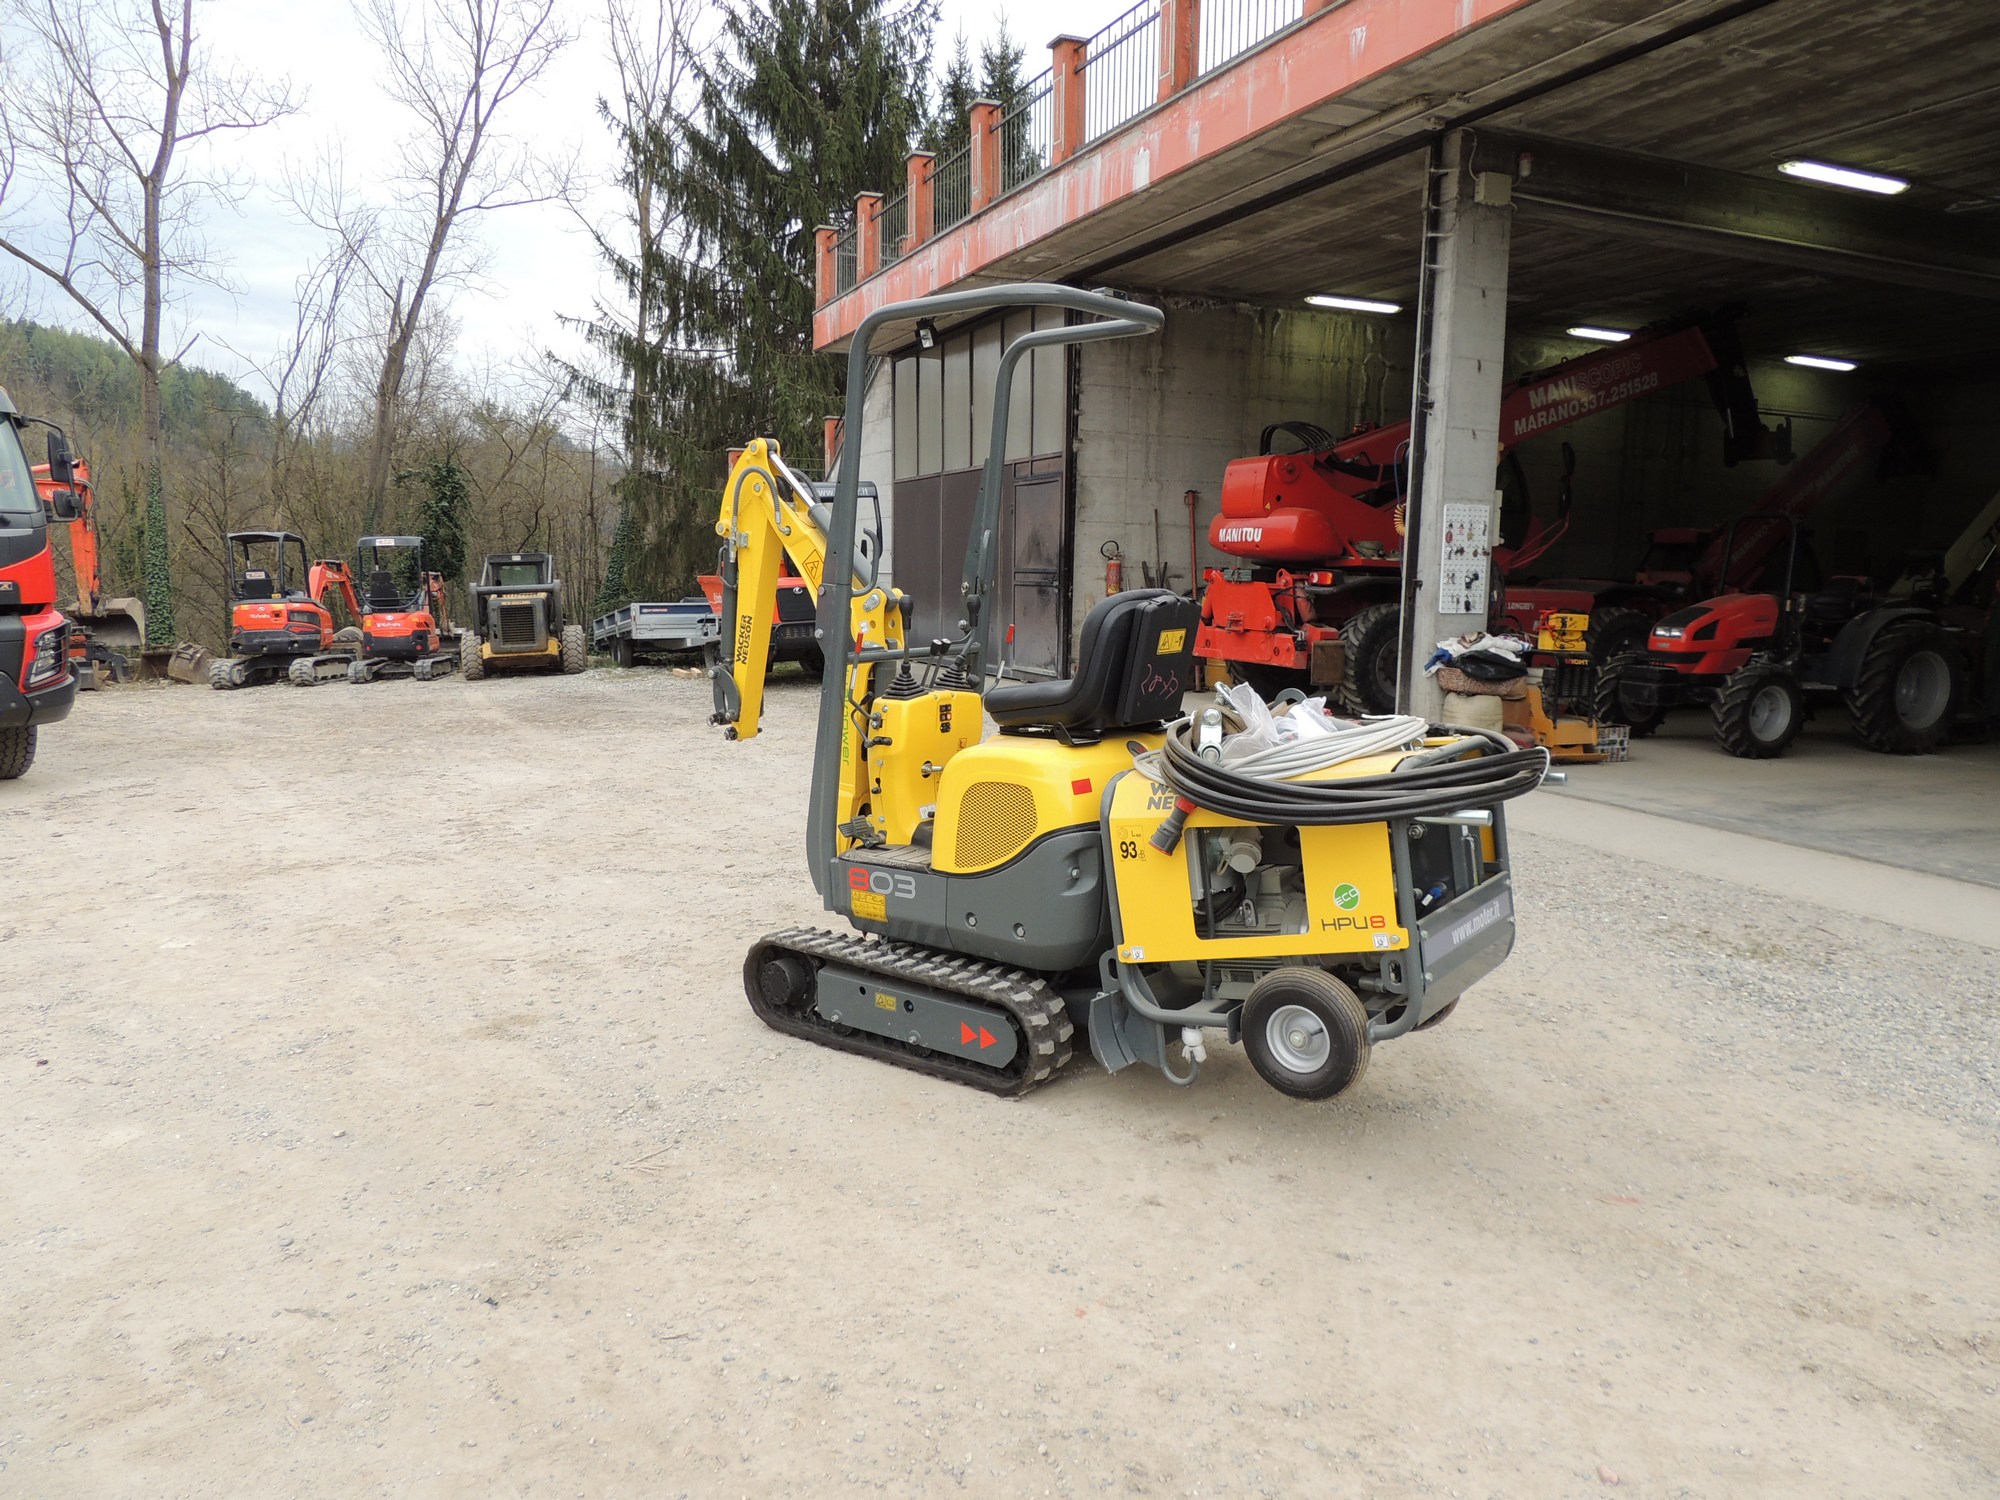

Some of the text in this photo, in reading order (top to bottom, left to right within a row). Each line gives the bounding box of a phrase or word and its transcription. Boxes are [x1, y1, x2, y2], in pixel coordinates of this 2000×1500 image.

[1514, 400, 1580, 435] MARANO
[1218, 527, 1262, 542] MANITOU
[736, 614, 748, 662] WACKER
[741, 614, 753, 665] NEUSON
[1120, 841, 1138, 859] 93
[848, 867, 916, 899] 803
[1334, 888, 1359, 906] ECO
[1321, 915, 1386, 932] HPU8
